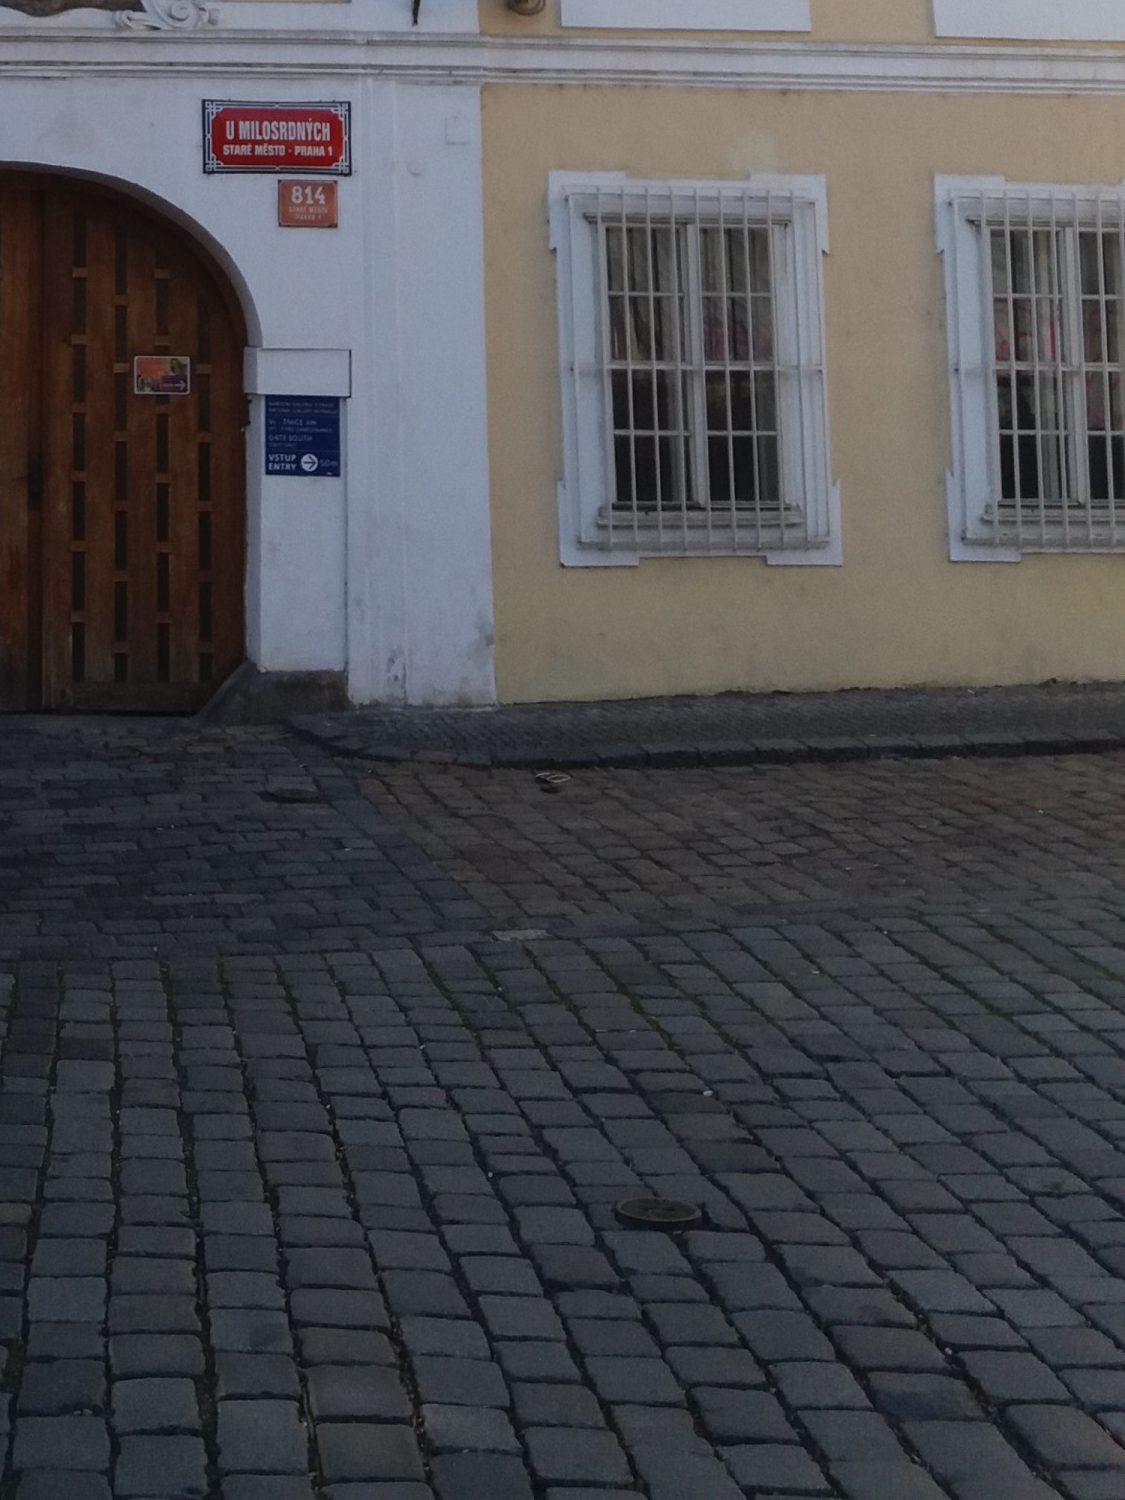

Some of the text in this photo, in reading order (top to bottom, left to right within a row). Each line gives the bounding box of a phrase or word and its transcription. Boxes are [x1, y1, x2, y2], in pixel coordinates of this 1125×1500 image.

[226, 118, 331, 142] U MILOSRDNÝCH
[223, 143, 252, 156] STARÉ
[255, 143, 286, 157] MĚSTO
[294, 145, 326, 157] PRAHA
[327, 146, 333, 157] 1
[291, 186, 326, 204] 814
[268, 453, 297, 462] VSTUP
[268, 462, 297, 471] ENTRY
